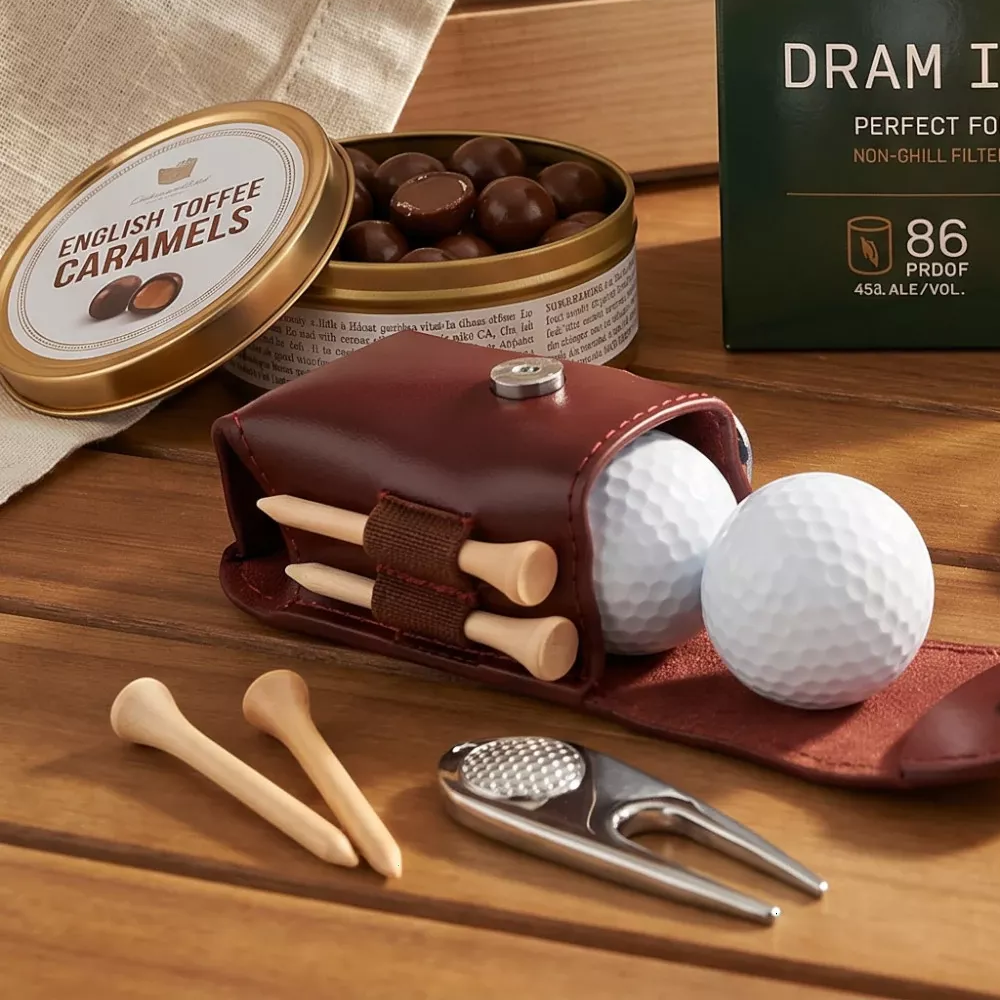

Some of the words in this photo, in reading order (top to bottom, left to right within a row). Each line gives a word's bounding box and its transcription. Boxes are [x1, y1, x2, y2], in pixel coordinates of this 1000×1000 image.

[784, 42, 943, 89] DRAM
[854, 116, 959, 137] PERFECT
[58, 209, 165, 258] ENGLISH
[173, 177, 265, 222] TOFFEE
[906, 218, 968, 258] 86
[53, 205, 253, 289] CARAMELS
